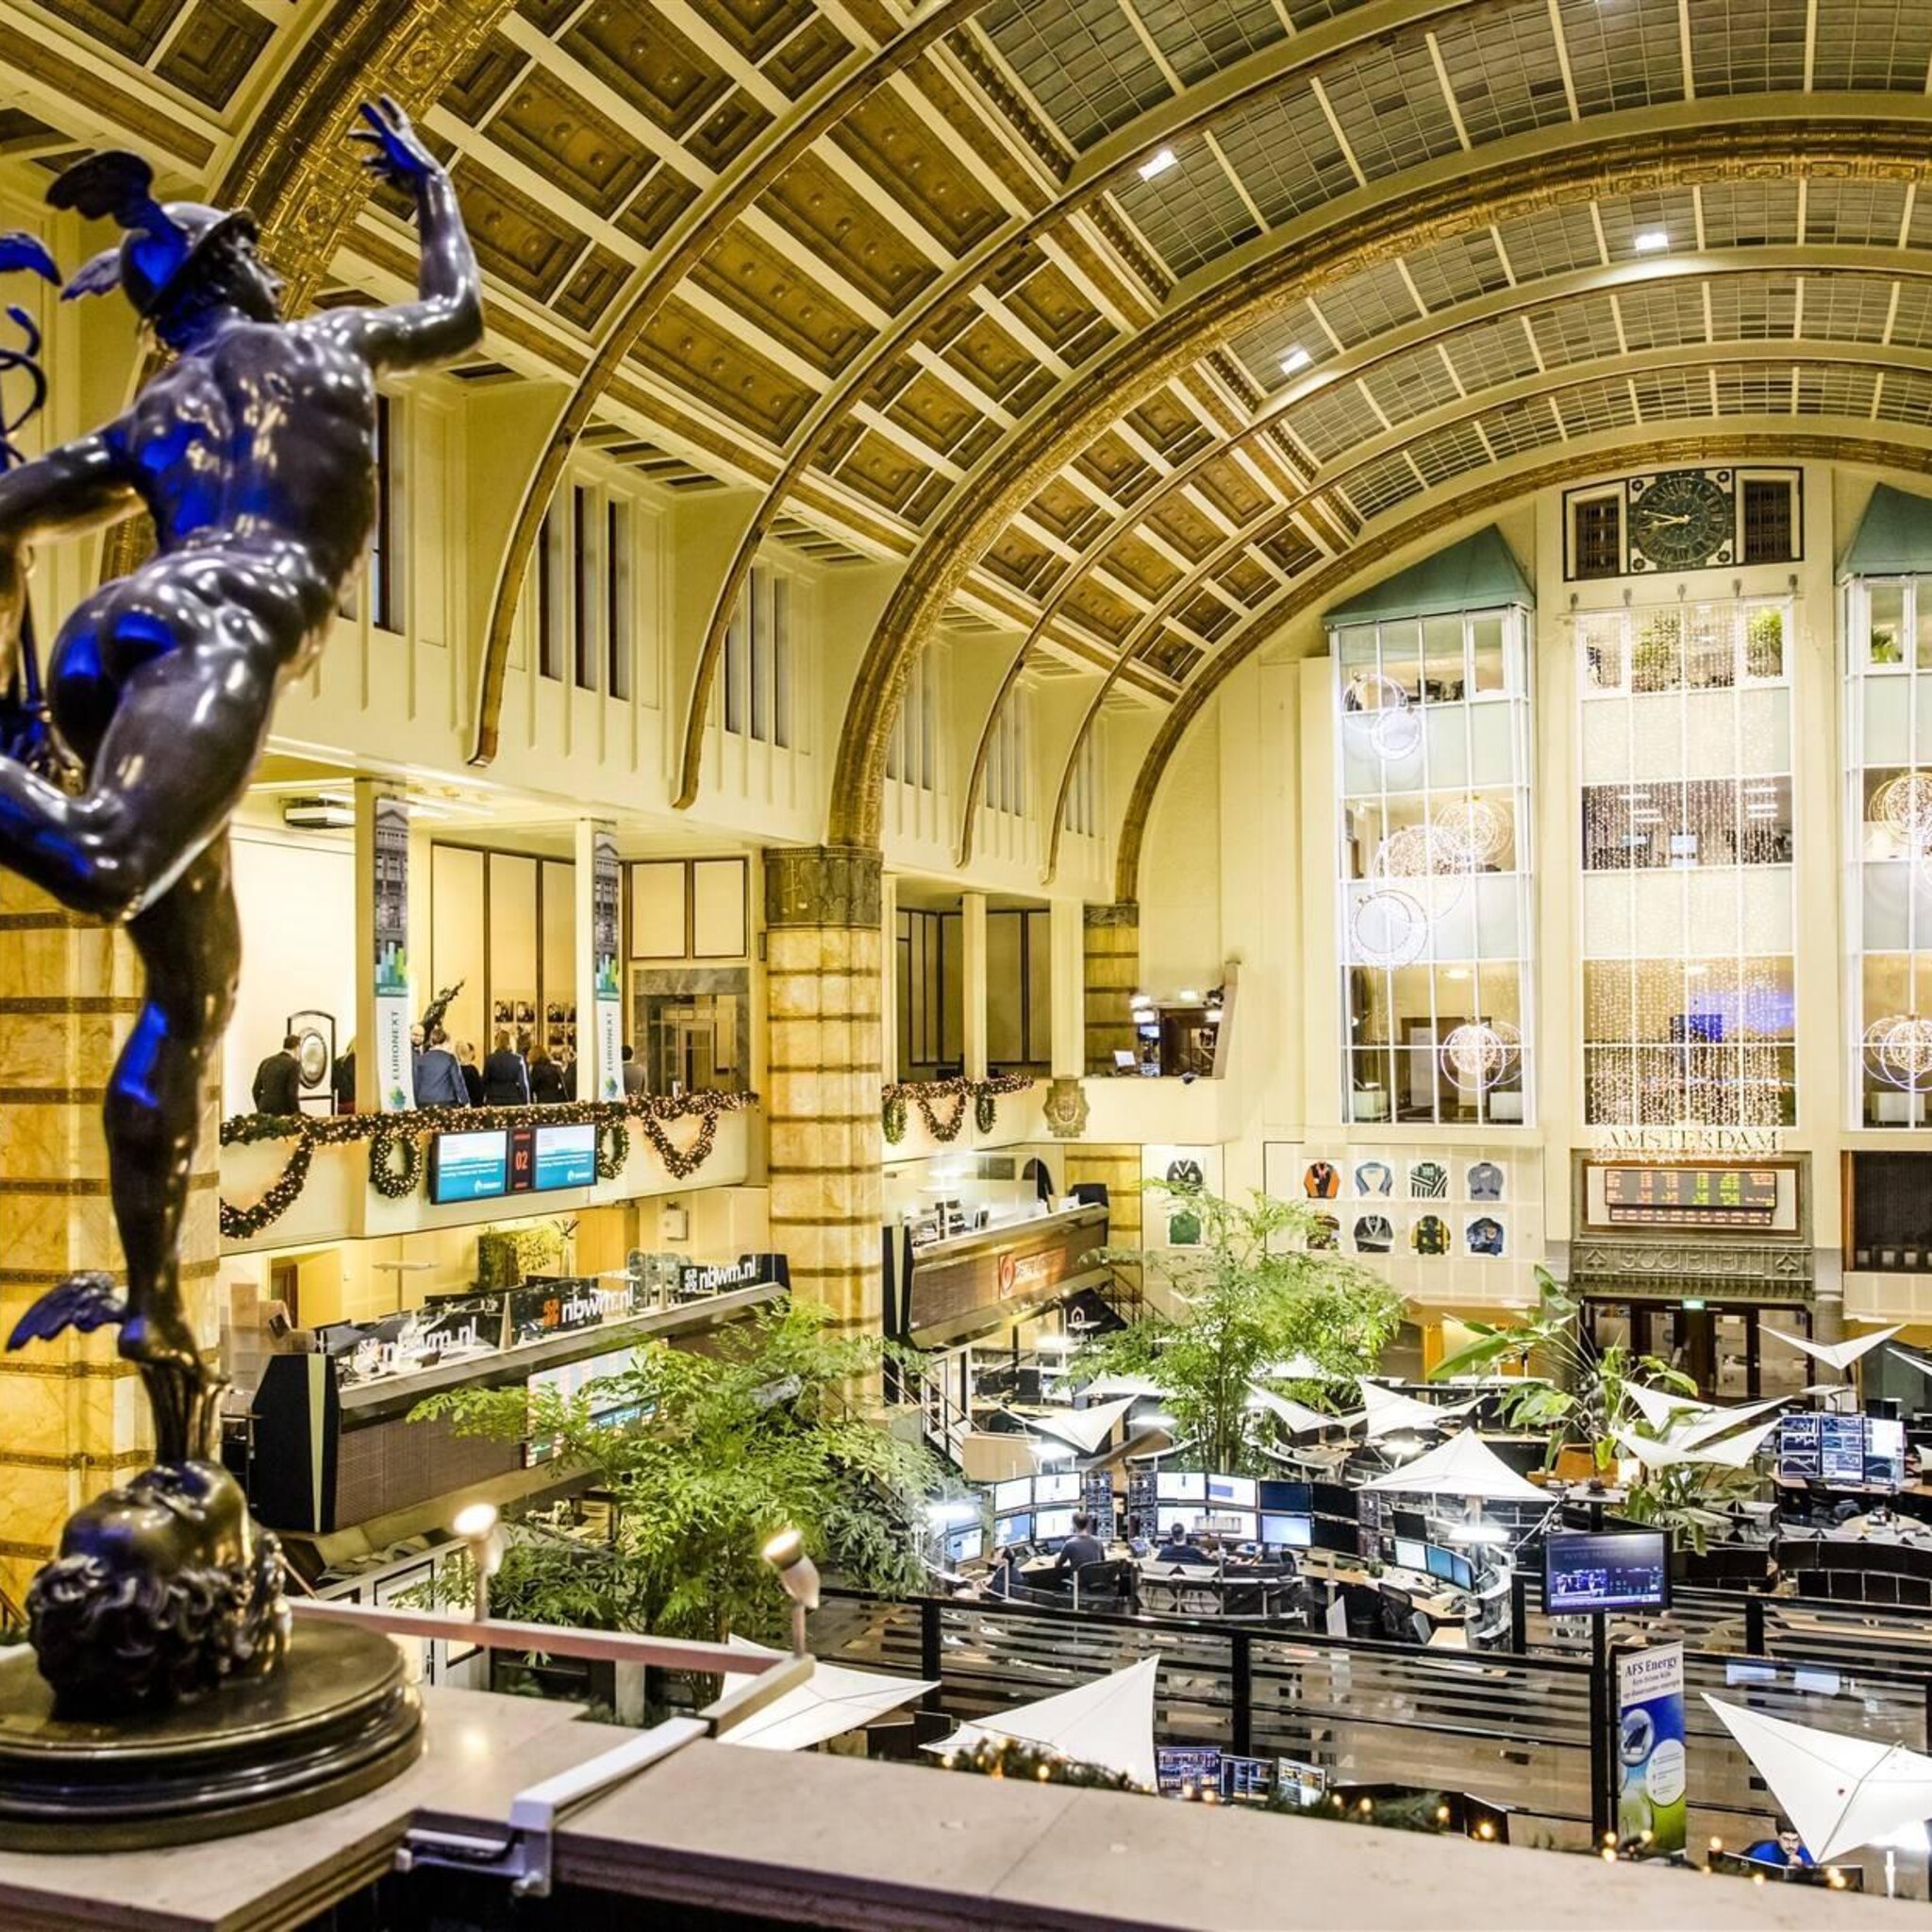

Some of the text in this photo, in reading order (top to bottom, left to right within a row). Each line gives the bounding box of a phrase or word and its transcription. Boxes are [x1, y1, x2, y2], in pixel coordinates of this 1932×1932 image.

[391, 1011, 400, 1080] EURONEXT
[1604, 1130, 1777, 1149] AMSTERDAM
[515, 1151, 528, 1171] 02
[699, 1257, 756, 1290] nbwm.nl
[561, 1282, 634, 1324] nbwm.nl
[1625, 1662, 1643, 1677] AFS
[1645, 1657, 1677, 1672] Energy
